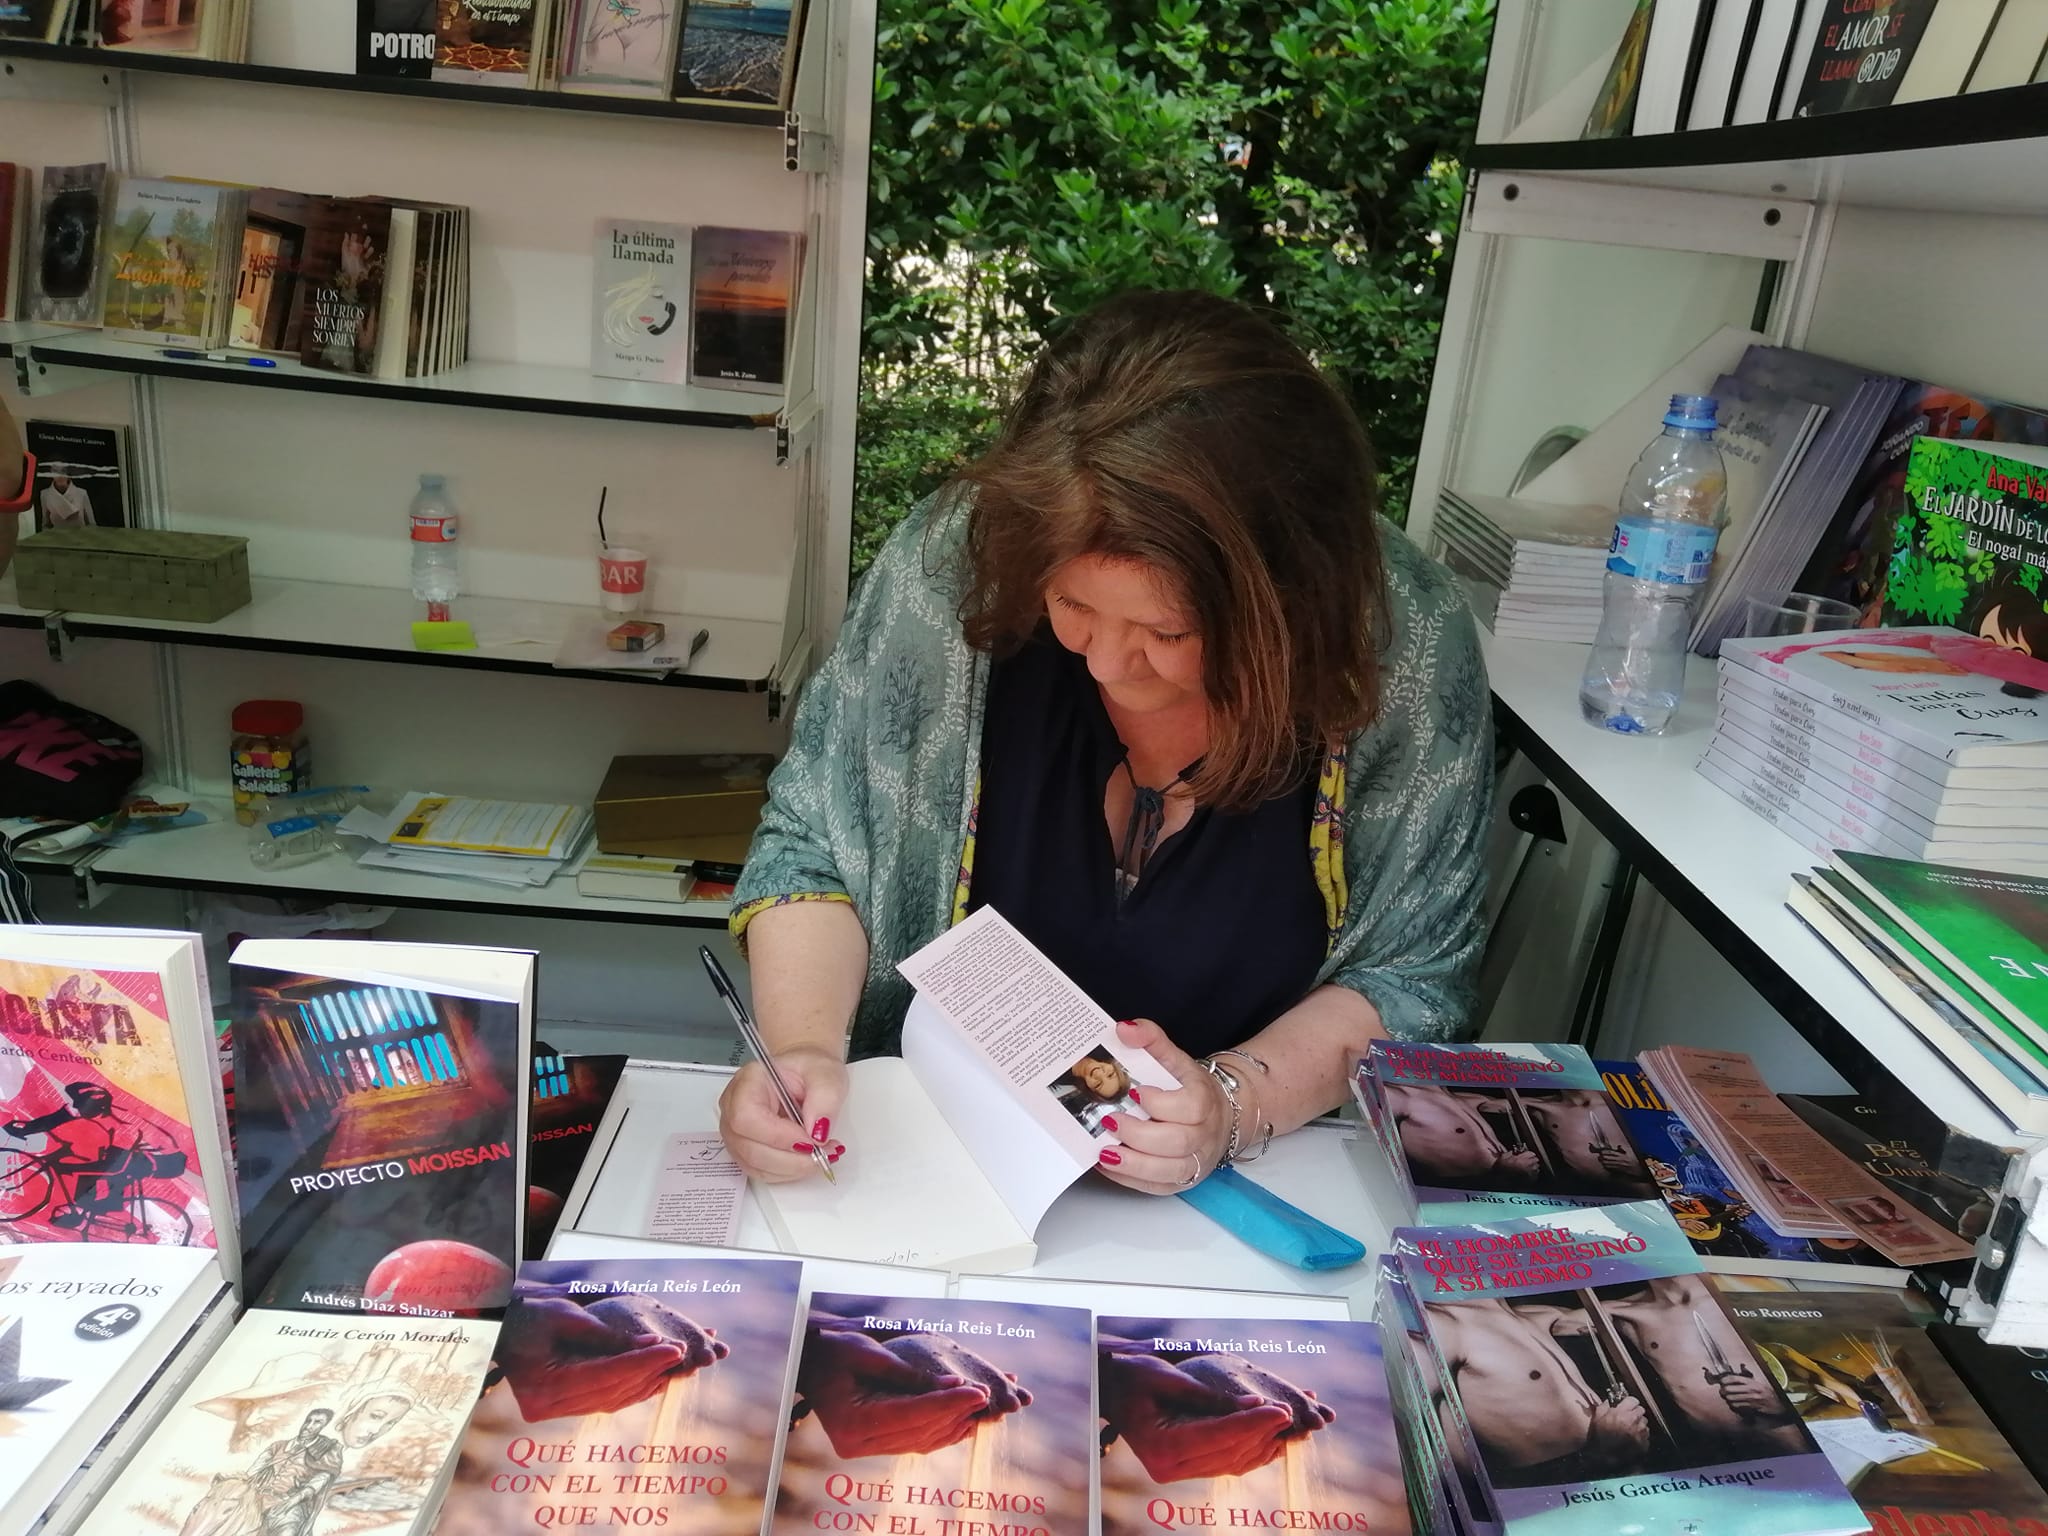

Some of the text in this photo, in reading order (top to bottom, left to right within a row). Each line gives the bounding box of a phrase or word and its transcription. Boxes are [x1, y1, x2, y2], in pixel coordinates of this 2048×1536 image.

[1835, 15, 1890, 51] AMOR
[613, 229, 675, 249] La última
[612, 245, 674, 264] llamada
[317, 288, 339, 302] LOS
[1987, 466, 2019, 495] Ana
[1944, 492, 2015, 535] JARDÍN
[2016, 518, 2034, 541] DE
[1968, 530, 1983, 549] El
[1985, 538, 2022, 561] nogal
[233, 764, 281, 780] Galletas
[238, 780, 289, 794] Saladas
[38, 1050, 103, 1065] Centeno
[1471, 1058, 1565, 1074] ASESINÓ
[1438, 1070, 1520, 1084] MISMO
[290, 1141, 511, 1195] PROYECTO MOISSAN
[1465, 1193, 1505, 1206] Jesús
[1508, 1194, 1561, 1207] García
[1454, 1227, 1577, 1253] HOMBRE
[1424, 1231, 1647, 1279] QUE SE ASESINÓ
[39, 1278, 163, 1300] rayados
[568, 1280, 741, 1294] Rosa María Reis León
[1433, 1263, 1593, 1293] A SÍ MISMO
[301, 1291, 455, 1319] Andrés Díaz Salazar
[1733, 1308, 1823, 1320] los Roncero
[78, 1320, 115, 1340] edición
[277, 1325, 470, 1346] Beatriz Cerón Morales
[863, 1315, 1036, 1340] Rosa María Reis León
[1153, 1337, 1327, 1355] Rosa María Reis León
[506, 1437, 727, 1469] QUÉ HACEMOS
[490, 1474, 727, 1497] CON EL TIEMPO
[825, 1473, 1046, 1516] QUÉ HACEMOS
[1561, 1465, 1776, 1509] Jesús García Araque
[534, 1505, 669, 1529] QUE NOS
[813, 1510, 879, 1533] CON
[888, 1515, 925, 1536] EL
[1146, 1499, 1369, 1532] QUÉ HACEMOS
